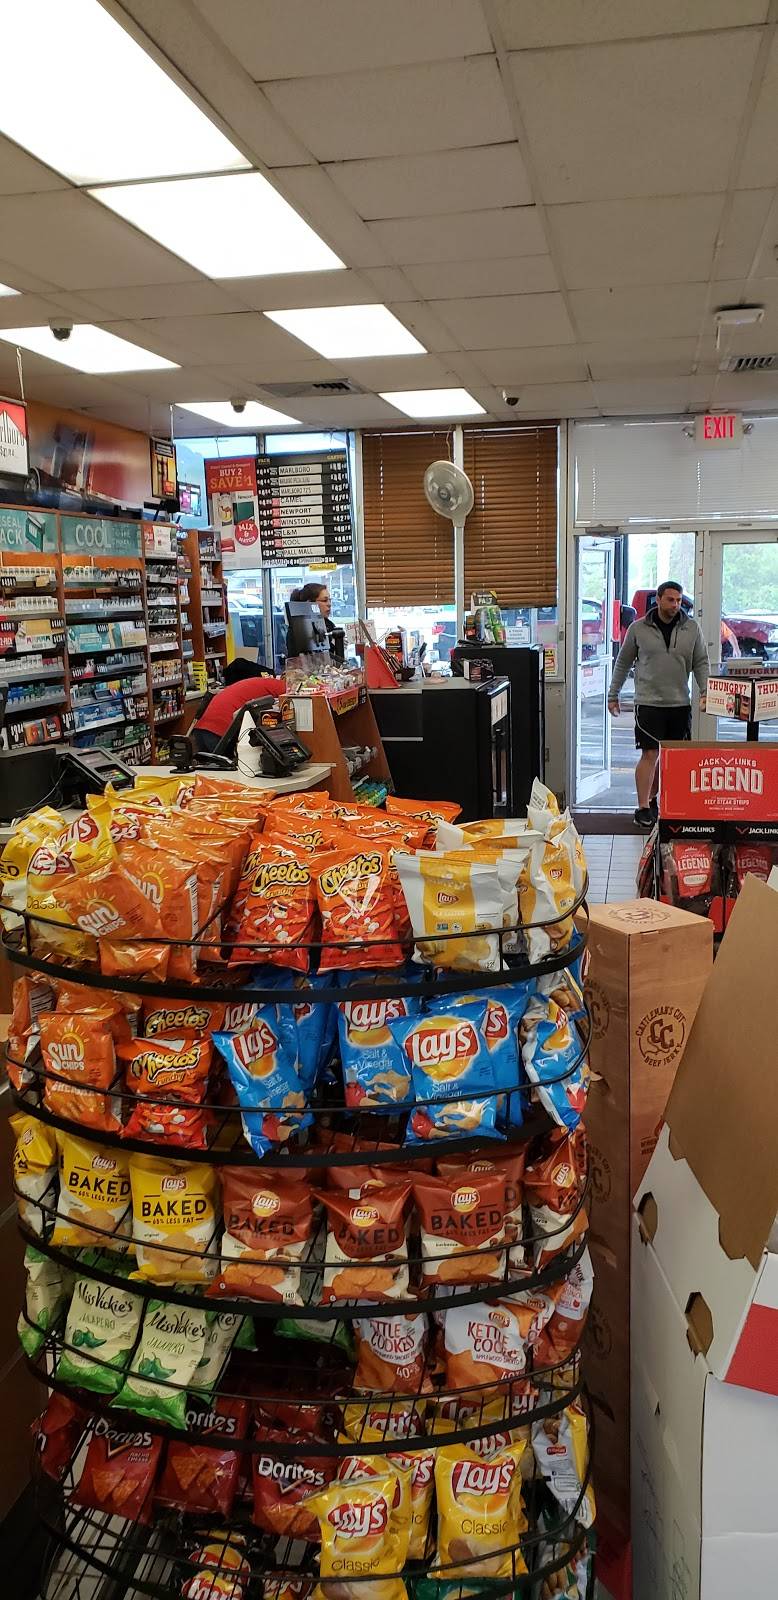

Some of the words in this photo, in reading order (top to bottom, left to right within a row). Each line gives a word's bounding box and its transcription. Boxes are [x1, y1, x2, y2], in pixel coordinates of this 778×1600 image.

[704, 416, 736, 438] EXIT
[210, 477, 243, 489] SAVE
[75, 524, 111, 548] COOL
[239, 522, 254, 531] MIX
[709, 680, 747, 695] THUNGRY?
[699, 758, 720, 767] JACK
[690, 767, 764, 795] LEGEND
[320, 853, 381, 895] Cheetos
[678, 858, 710, 871] LEGEND
[251, 861, 310, 894] Cheetos
[78, 907, 119, 937] Sun
[98, 918, 127, 936] CHIPS
[145, 1006, 210, 1037] Cheetos
[673, 1008, 687, 1022] CUT
[48, 1042, 84, 1072] Sun
[363, 1049, 380, 1058] Salt
[381, 1048, 388, 1057] &
[644, 1056, 661, 1067] BEEF
[663, 1043, 682, 1066] JERKY
[62, 1061, 85, 1071] CHIPS
[131, 1047, 199, 1082] Cheetos
[357, 1059, 394, 1069] Vinegar
[432, 1082, 452, 1092] Salt
[69, 1171, 130, 1196] BAKED
[91, 1193, 105, 1201] LESS
[106, 1195, 118, 1203] FAT
[142, 1200, 207, 1216] BAKED
[229, 1214, 295, 1236] BAKED
[431, 1210, 501, 1230] BAKED
[338, 1223, 400, 1246] BAKED
[77, 1282, 97, 1306] Miss
[97, 1286, 134, 1318] Vickie's
[145, 1312, 175, 1333] Miss
[370, 1320, 401, 1339] TTLE
[371, 1333, 415, 1353] COOKED
[467, 1321, 509, 1345] KETTE
[186, 1410, 236, 1433] oritos
[258, 1457, 324, 1486] Doritos
[460, 1518, 509, 1535] Classic
[331, 1558, 380, 1573] Classic
